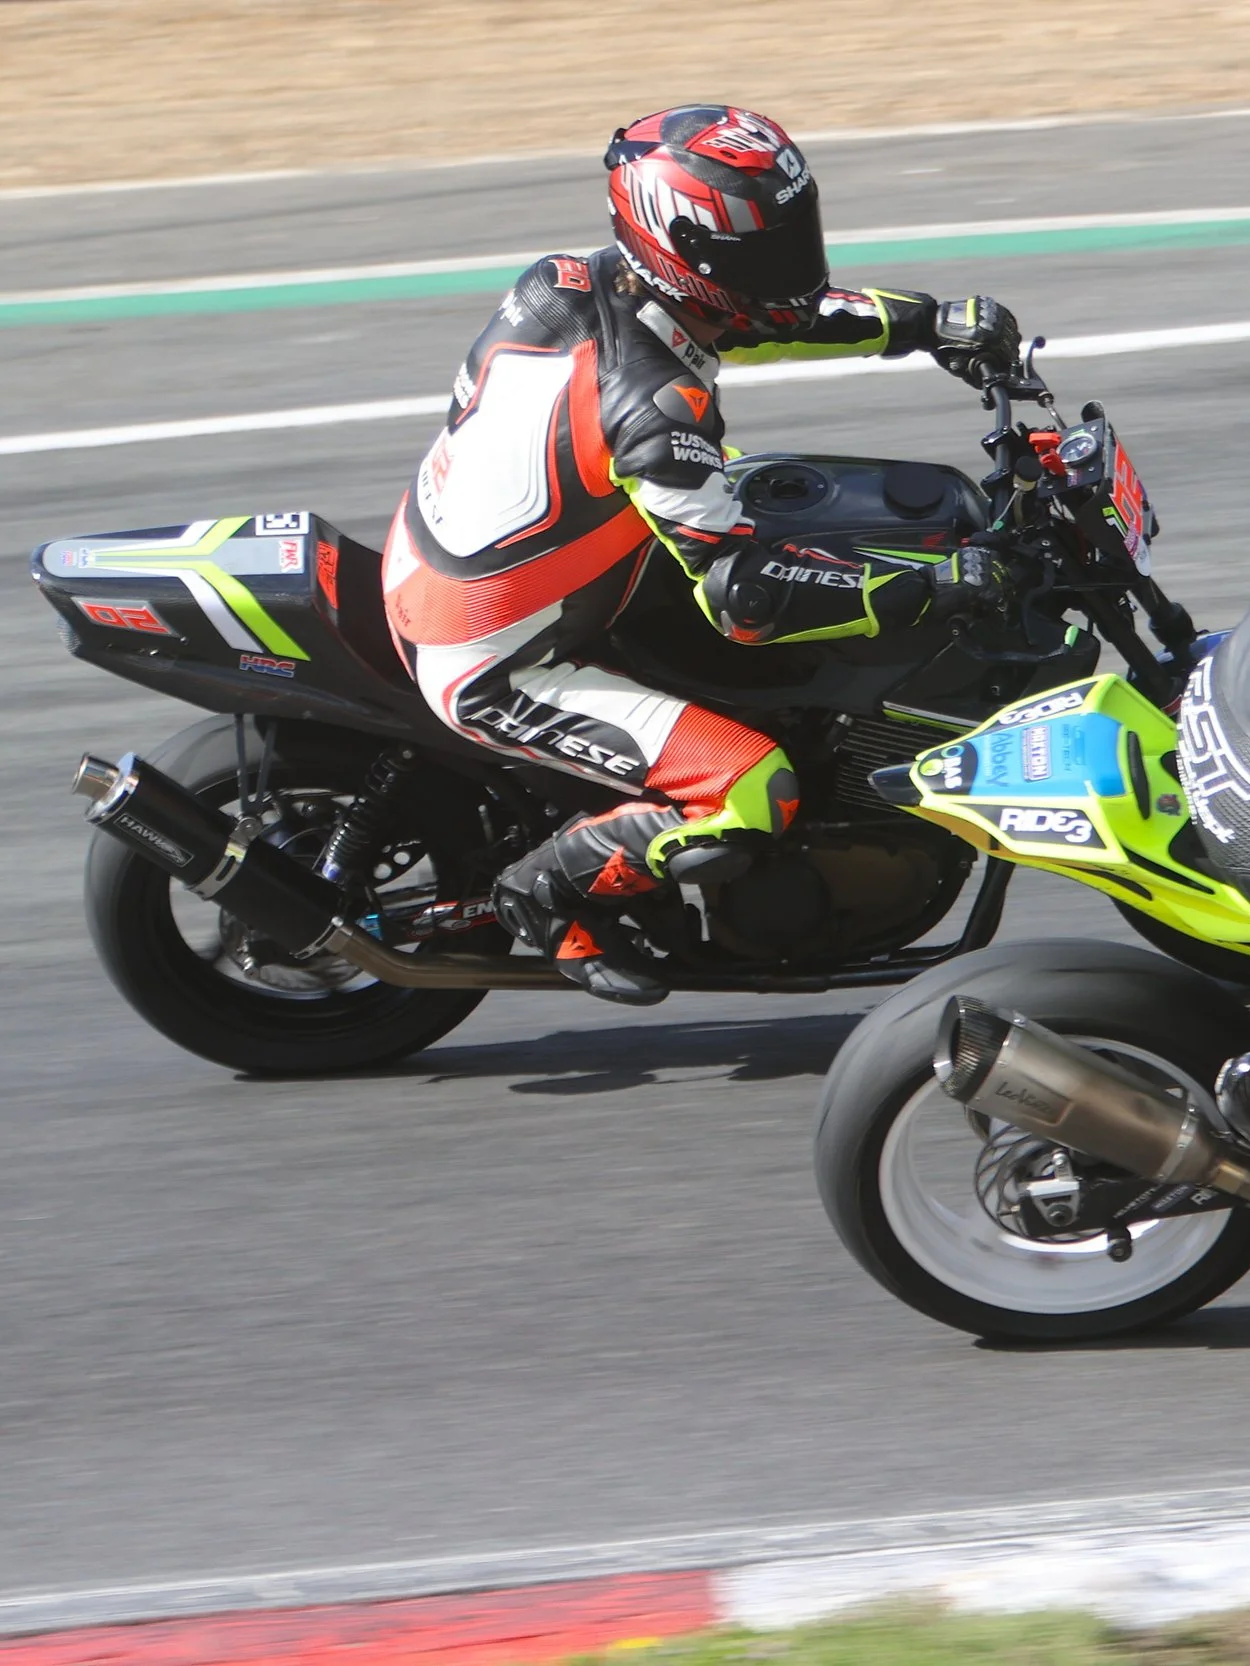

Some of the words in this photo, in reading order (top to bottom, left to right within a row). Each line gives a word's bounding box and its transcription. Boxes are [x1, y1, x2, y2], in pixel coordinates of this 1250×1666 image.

[672, 446, 723, 470] WORKS
[239, 654, 296, 679] HRC
[999, 808, 1093, 843] RIDE3
